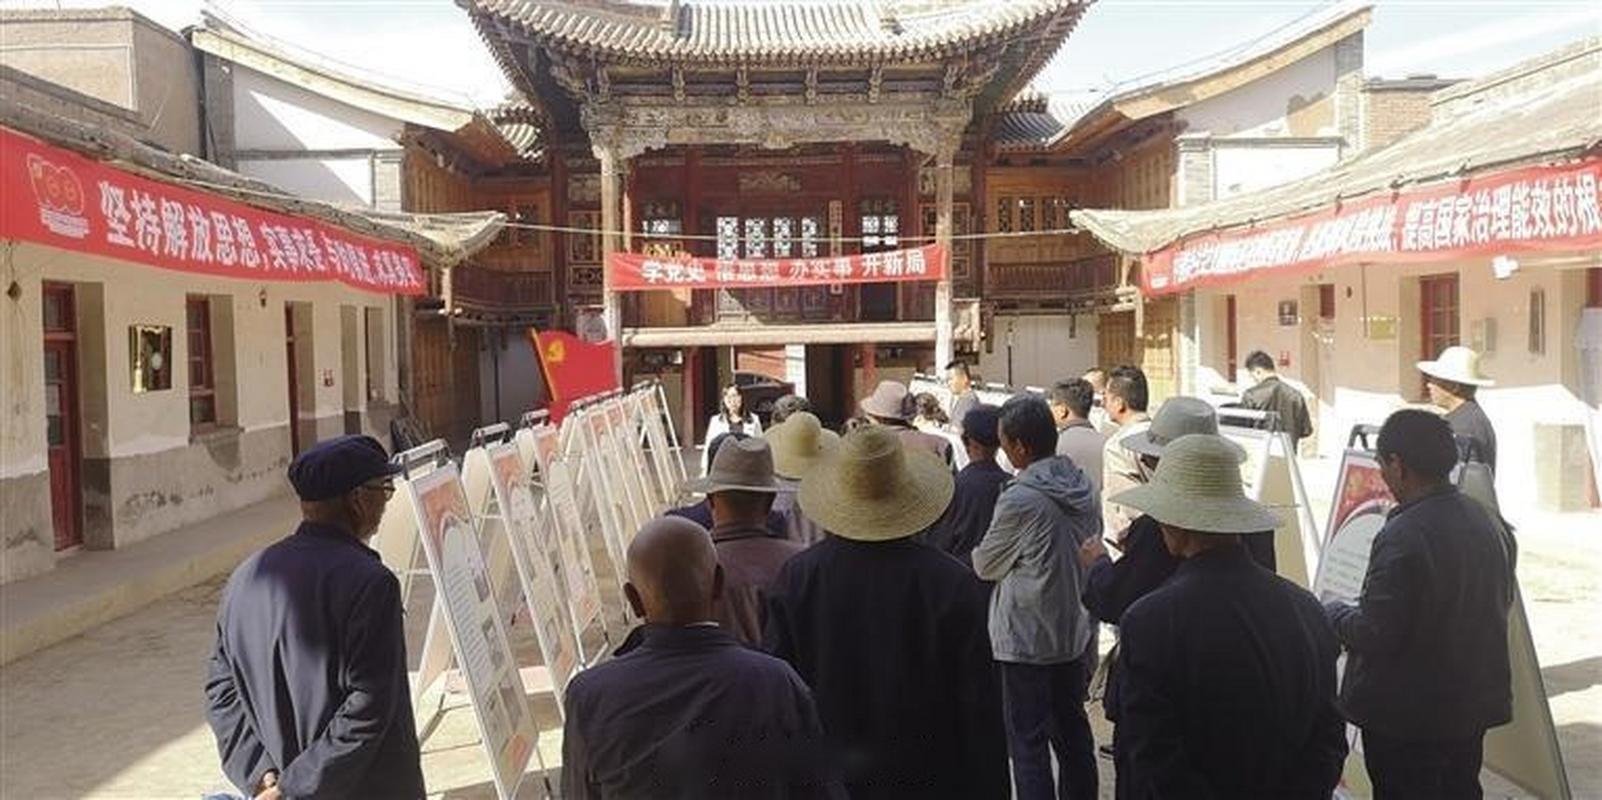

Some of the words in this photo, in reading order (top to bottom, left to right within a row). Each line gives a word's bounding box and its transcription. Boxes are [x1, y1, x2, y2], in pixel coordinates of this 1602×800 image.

[641, 259, 705, 283] 学党史
[788, 256, 853, 281] 办实事
[862, 246, 926, 277] 开新局
